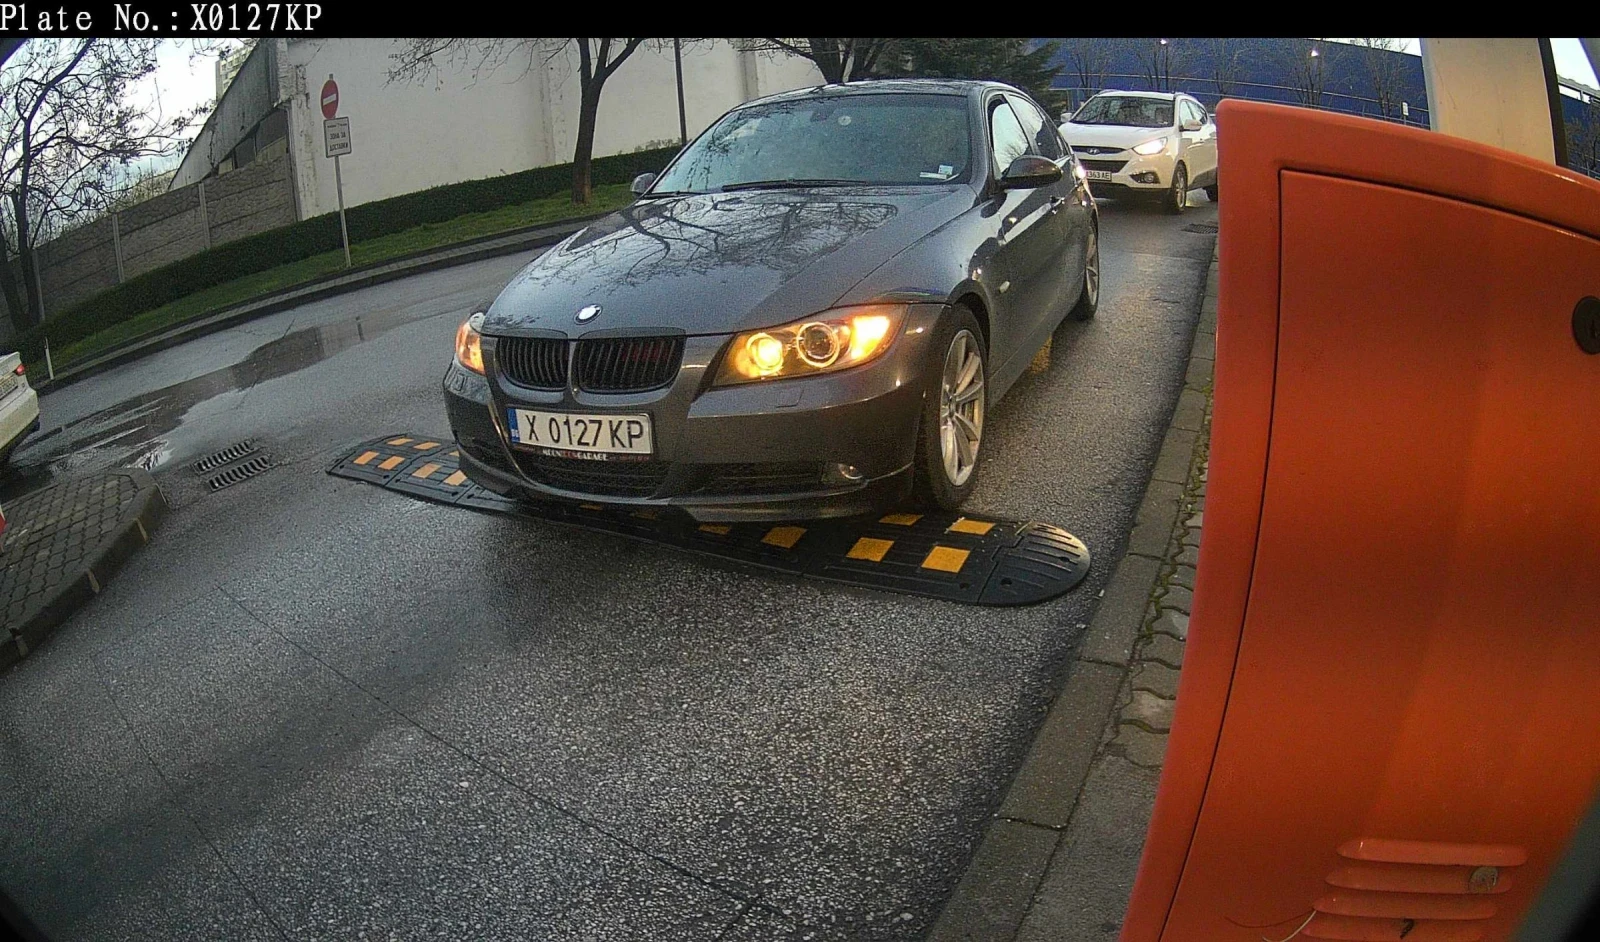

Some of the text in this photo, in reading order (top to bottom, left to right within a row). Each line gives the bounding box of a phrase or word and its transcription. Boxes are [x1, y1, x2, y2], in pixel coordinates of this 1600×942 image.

[525, 414, 643, 449] X 0127 KP
